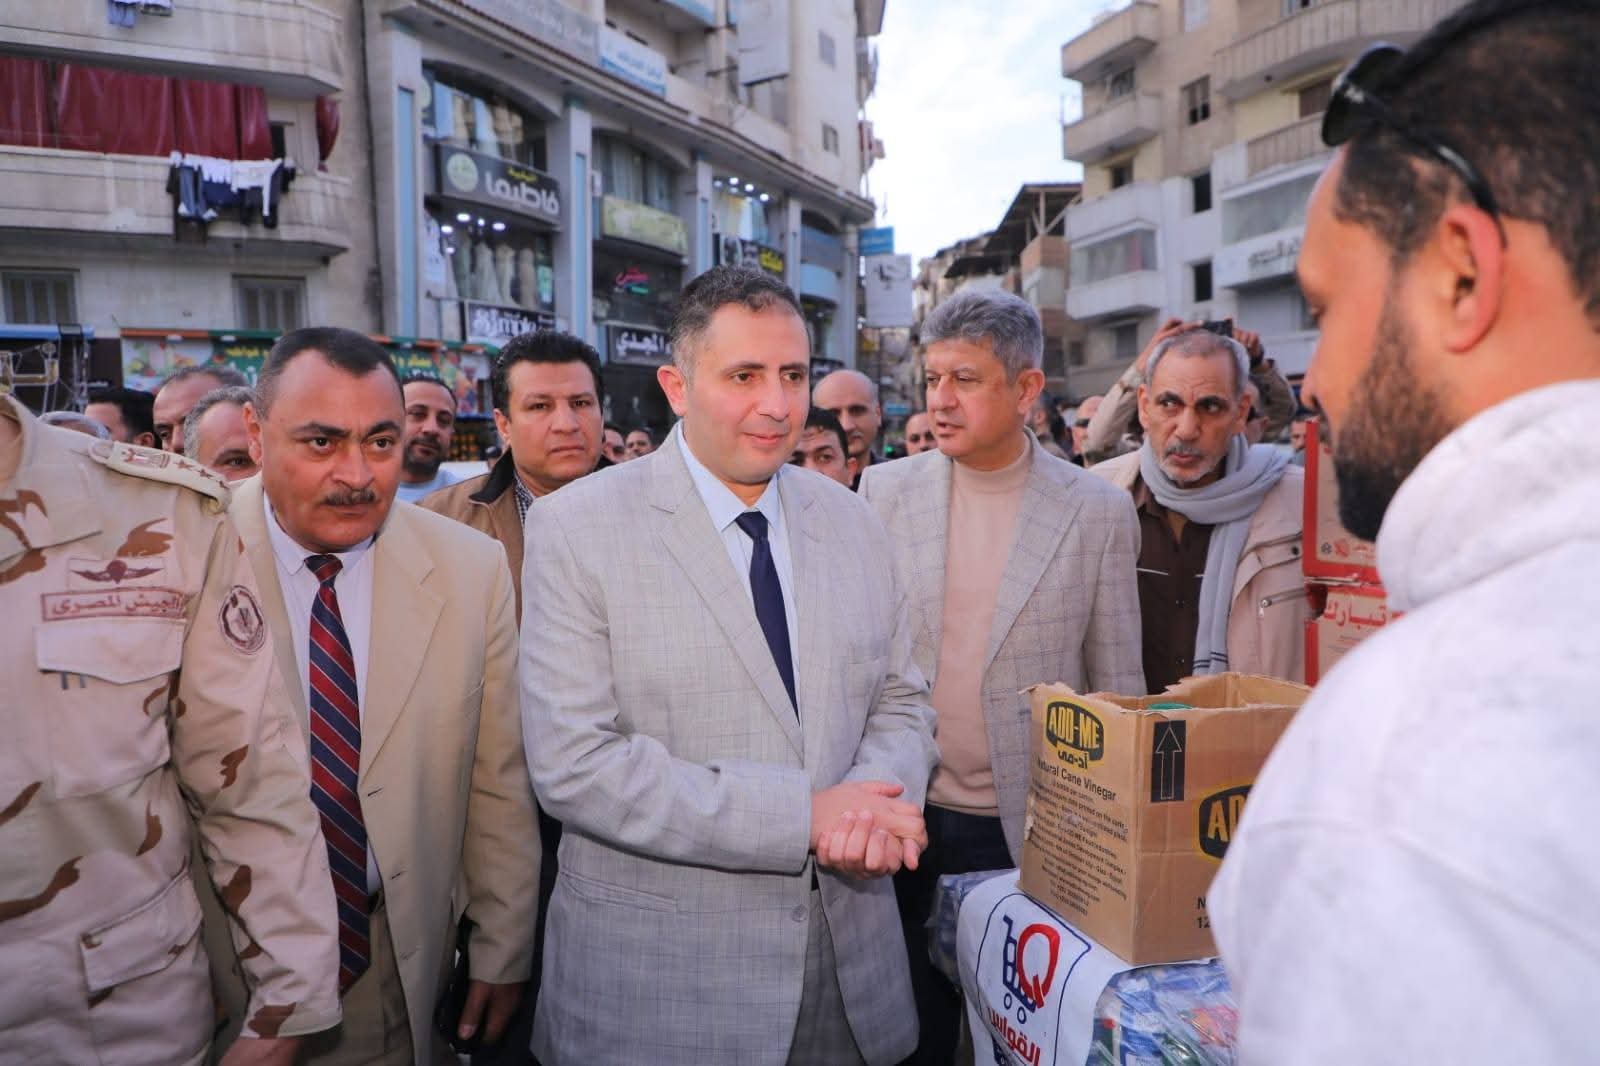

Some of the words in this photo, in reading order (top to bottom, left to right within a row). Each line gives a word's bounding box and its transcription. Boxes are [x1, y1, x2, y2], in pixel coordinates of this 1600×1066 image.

[485, 172, 559, 215] فاطيما
[1323, 602, 1386, 630] تبارك
[1048, 706, 1100, 749] ADD-ME
[1061, 768, 1082, 786] Cane
[1083, 777, 1116, 801] Vinegar
